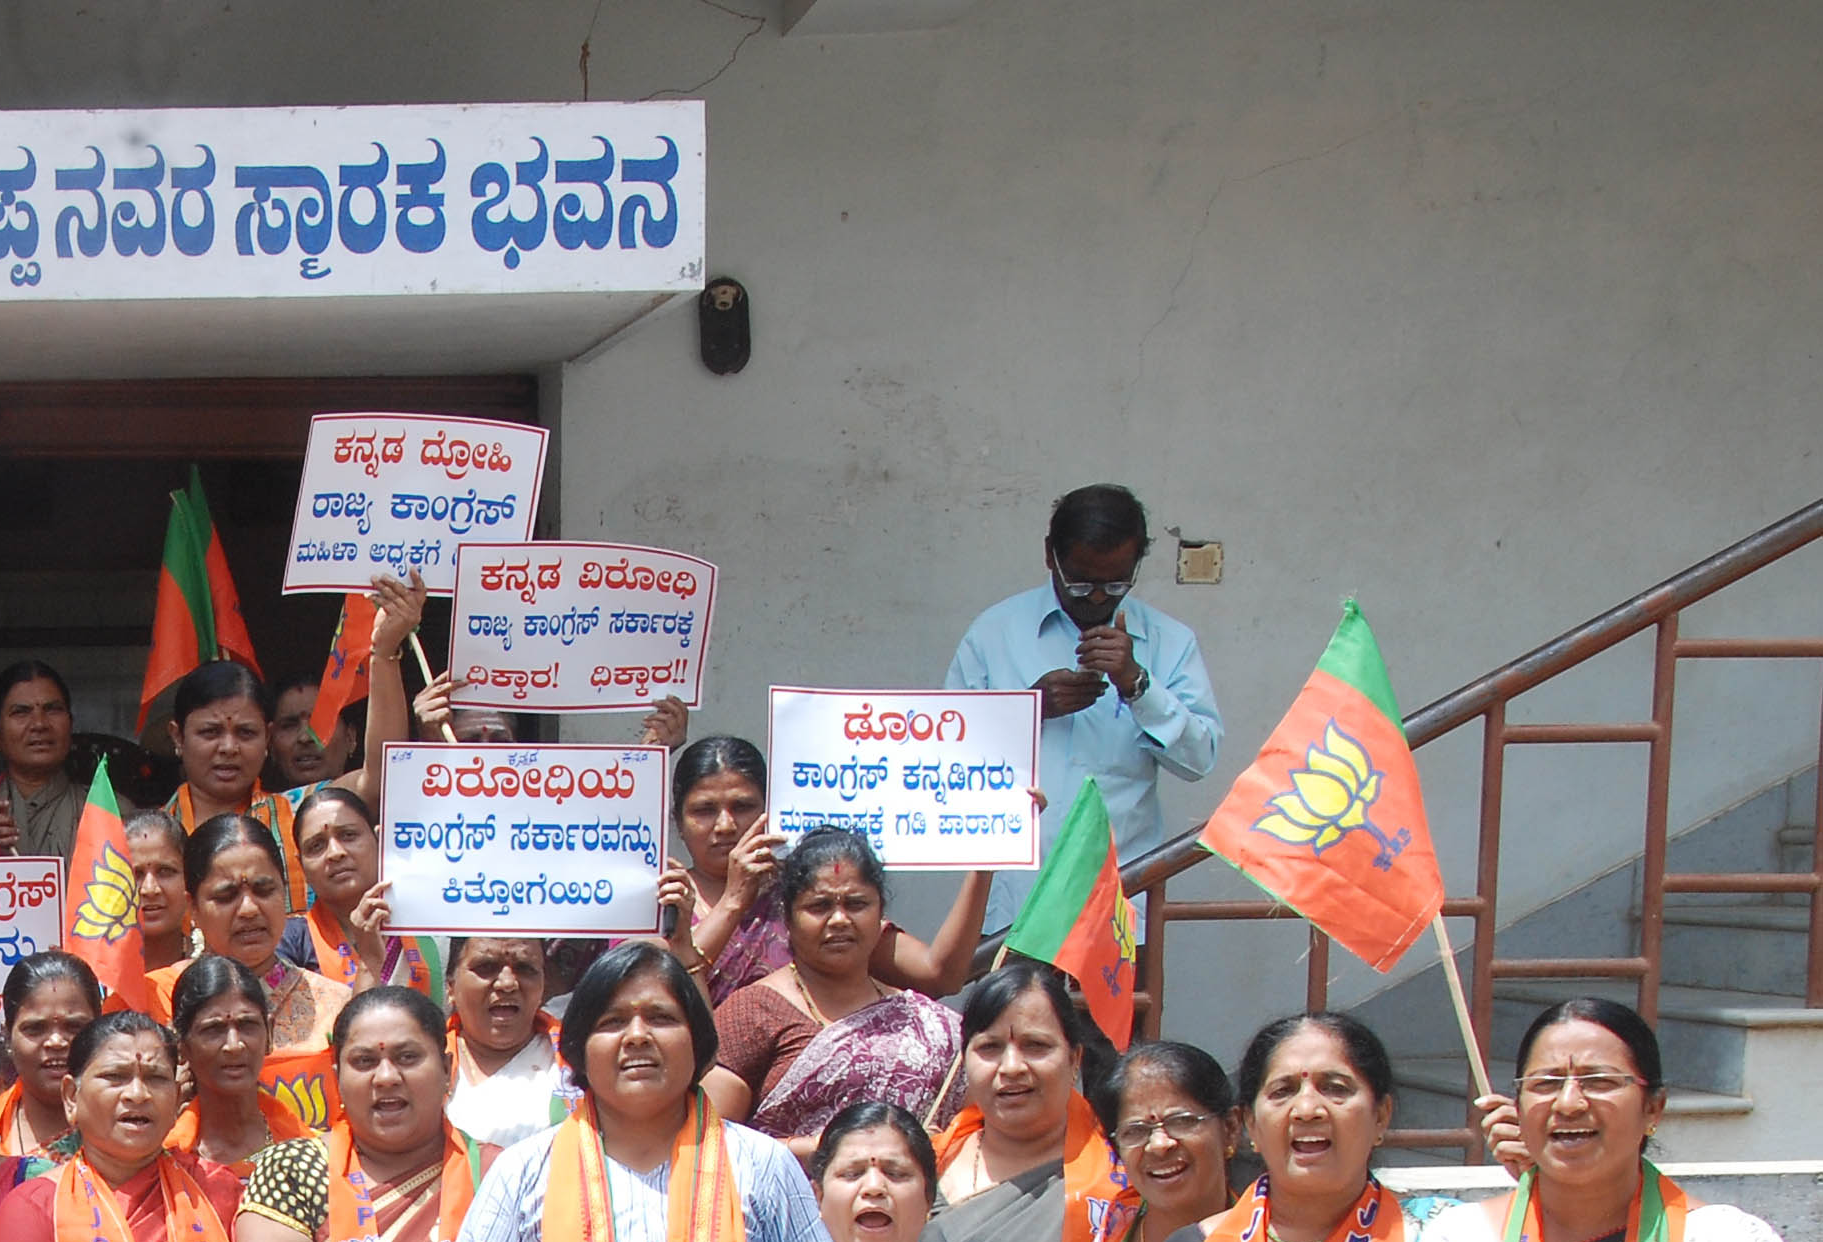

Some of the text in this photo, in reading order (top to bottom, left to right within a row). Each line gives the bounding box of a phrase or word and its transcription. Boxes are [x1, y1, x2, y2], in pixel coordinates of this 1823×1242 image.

[235, 137, 447, 280] ಸ್ಮಾರಕ
[470, 135, 680, 271] ಭವನ
[333, 429, 512, 480] ಕನ್ನಡ ದ್ರೋಹಿ
[312, 489, 516, 535] ರಾಜ್ಯ ಕಾಂಗ್ರೆಸ್
[296, 539, 358, 563] ಮಹಿಳಾ
[480, 556, 698, 604] ಕನ್ನಡ ವಿರೋಧಿ
[467, 606, 695, 651] ರಾಜ್ಯ ಕಾಂಗ್ರೆಸ್ ಸರ್ಕಾರಕ್ಕೆ
[421, 755, 636, 805] ವಿರೋಧಿಯ
[792, 754, 1015, 804] ಕಾಂಗ್ರೆಸ್ ಕನ್ನಡಿಗರು
[393, 812, 658, 867] ಕಾಂಗ್ರೆಸ್ ಸರ್ಕಾರವನ್ನು
[895, 811, 927, 835] ಗಡಿ
